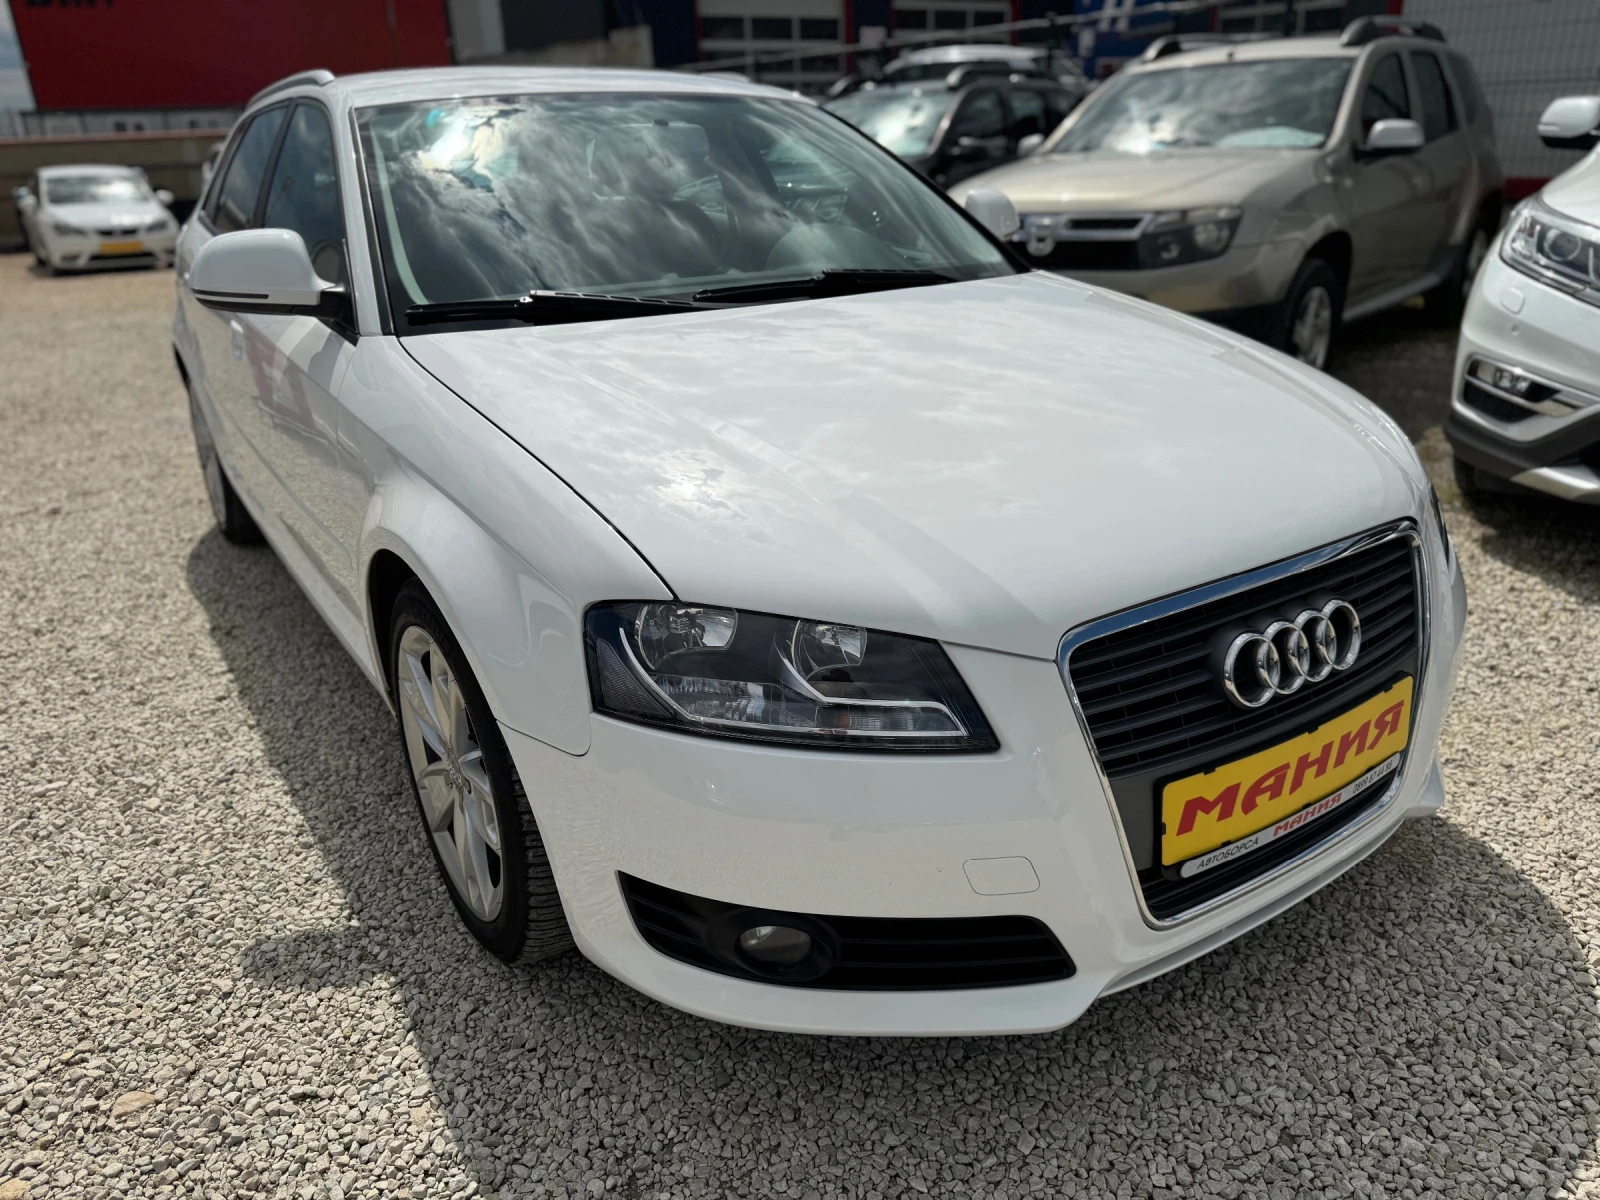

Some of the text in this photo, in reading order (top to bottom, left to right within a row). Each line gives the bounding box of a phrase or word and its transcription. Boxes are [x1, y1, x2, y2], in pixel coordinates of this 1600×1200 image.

[1176, 700, 1404, 836] МАНИЯ
[1197, 837, 1259, 869] АВТОБОРСА
[1273, 792, 1343, 836] МАНИЯ
